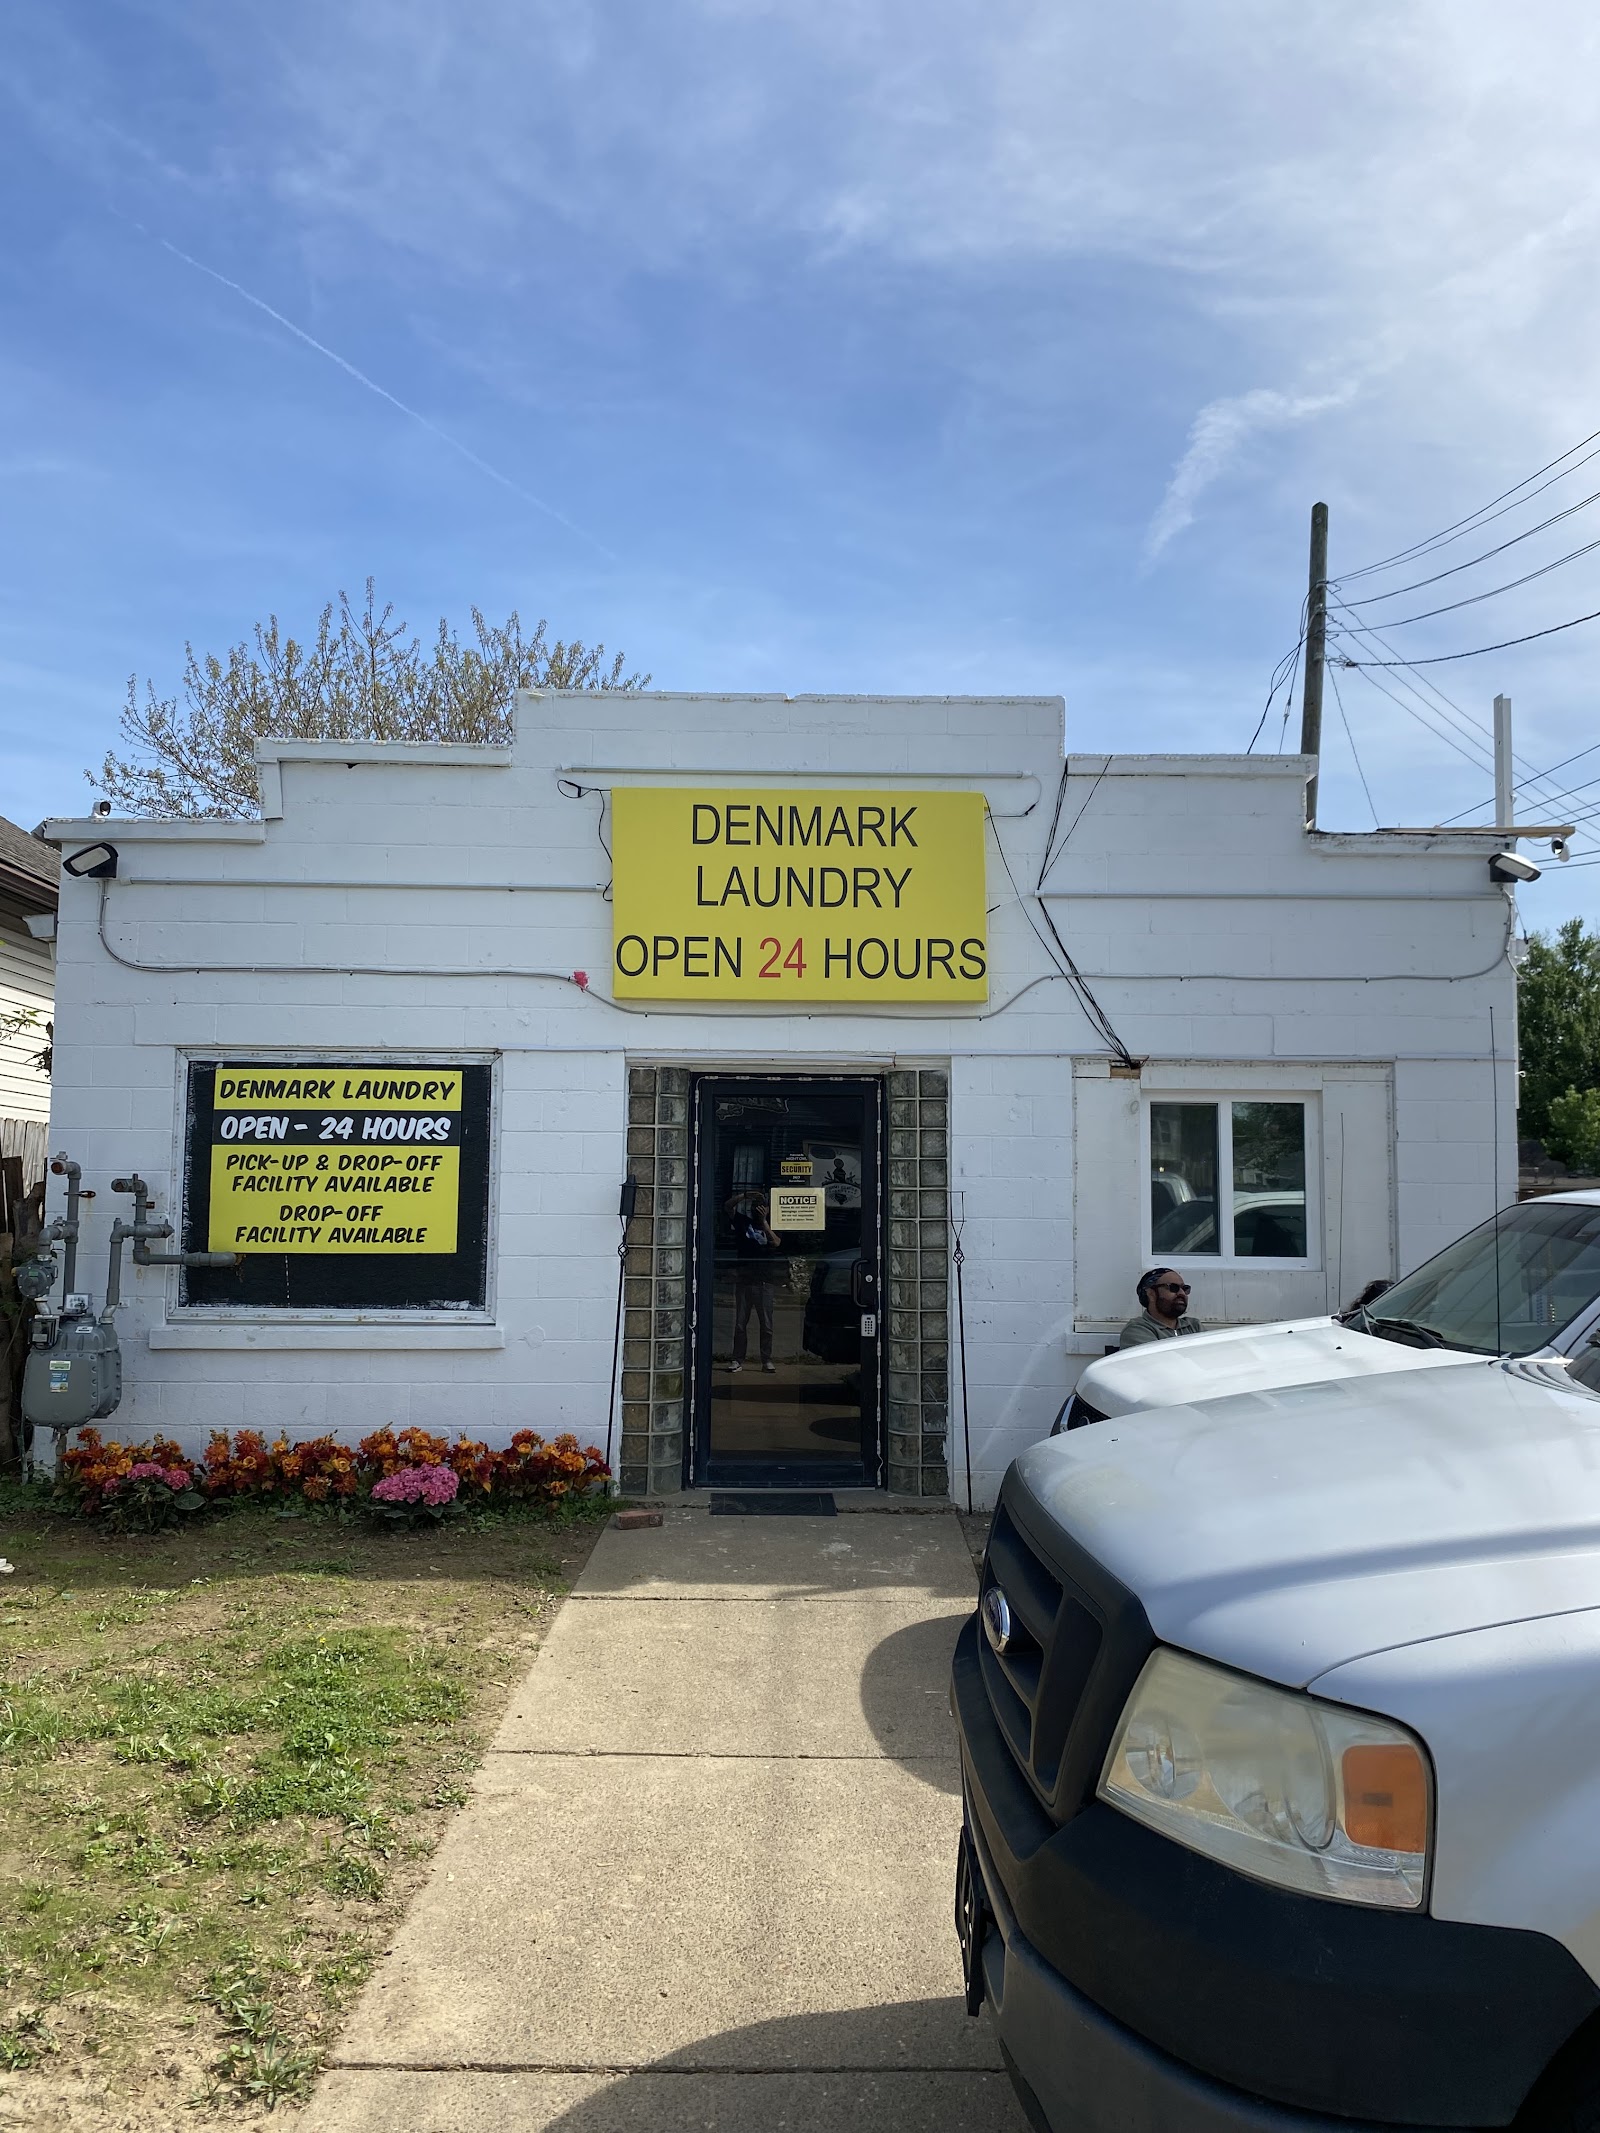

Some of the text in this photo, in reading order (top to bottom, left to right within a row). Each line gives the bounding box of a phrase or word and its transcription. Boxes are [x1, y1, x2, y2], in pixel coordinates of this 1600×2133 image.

[693, 804, 918, 847] DENMARK
[698, 866, 912, 908] LAUNDRY
[616, 935, 986, 979] OPEN 24 HOURS
[220, 1080, 455, 1100] DENMARK LAUNDRY
[221, 1116, 289, 1139] OPEN
[319, 1117, 353, 1139] 24
[362, 1117, 451, 1140] HOURS
[226, 1154, 443, 1171] PICK-UP & DROP-OFF
[781, 1165, 812, 1173] SECURITY
[232, 1176, 434, 1192] FACILITY AVAILABLE
[780, 1196, 816, 1204] NOTICE
[280, 1205, 383, 1221] DROP-OFF
[236, 1226, 427, 1243] FACILITY AVAILABLE
